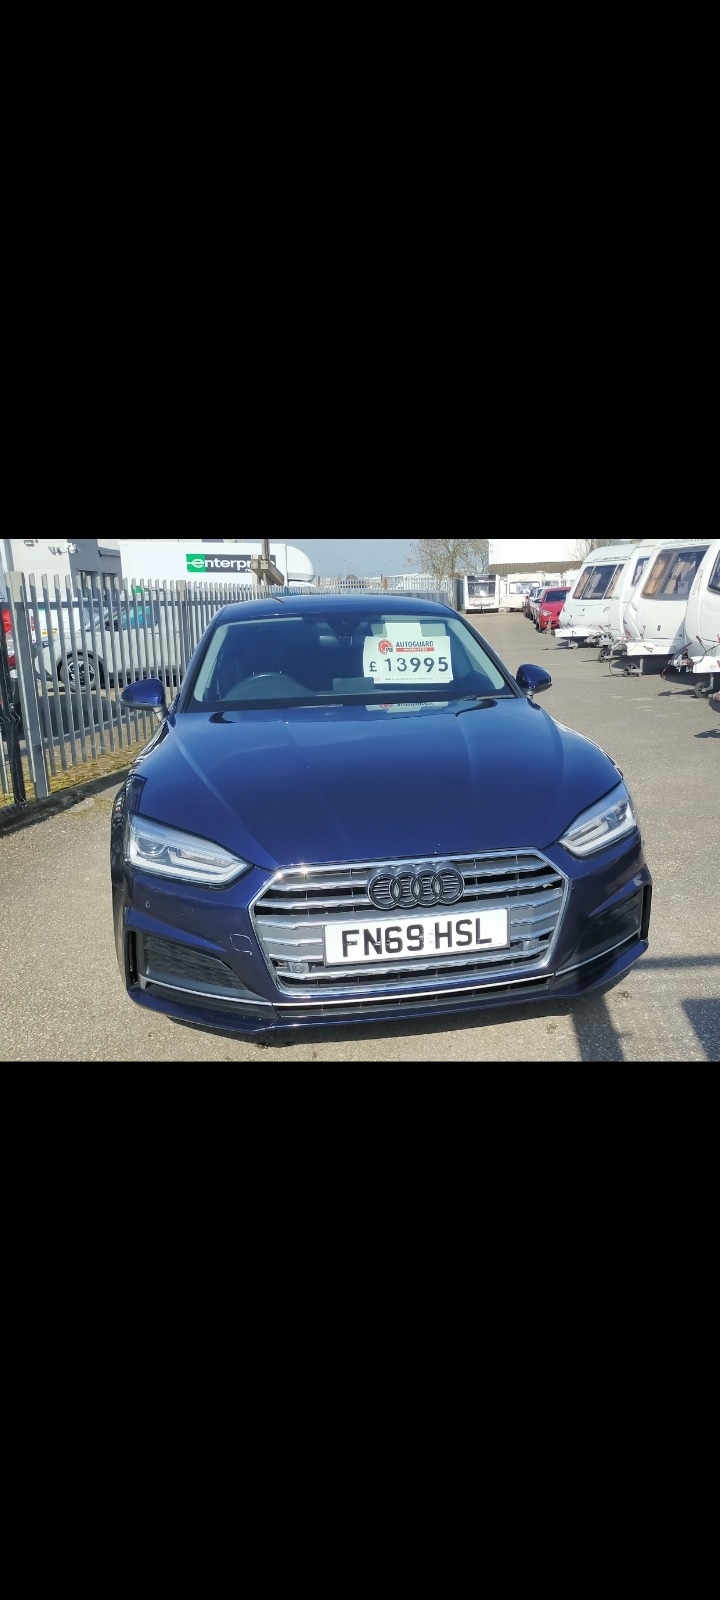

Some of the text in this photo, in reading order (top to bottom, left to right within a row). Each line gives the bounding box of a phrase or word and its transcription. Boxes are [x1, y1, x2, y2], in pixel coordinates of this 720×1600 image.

[192, 558, 275, 571] enterpr
[369, 657, 449, 673] £ 13995
[341, 917, 493, 958] FN69 HSL
